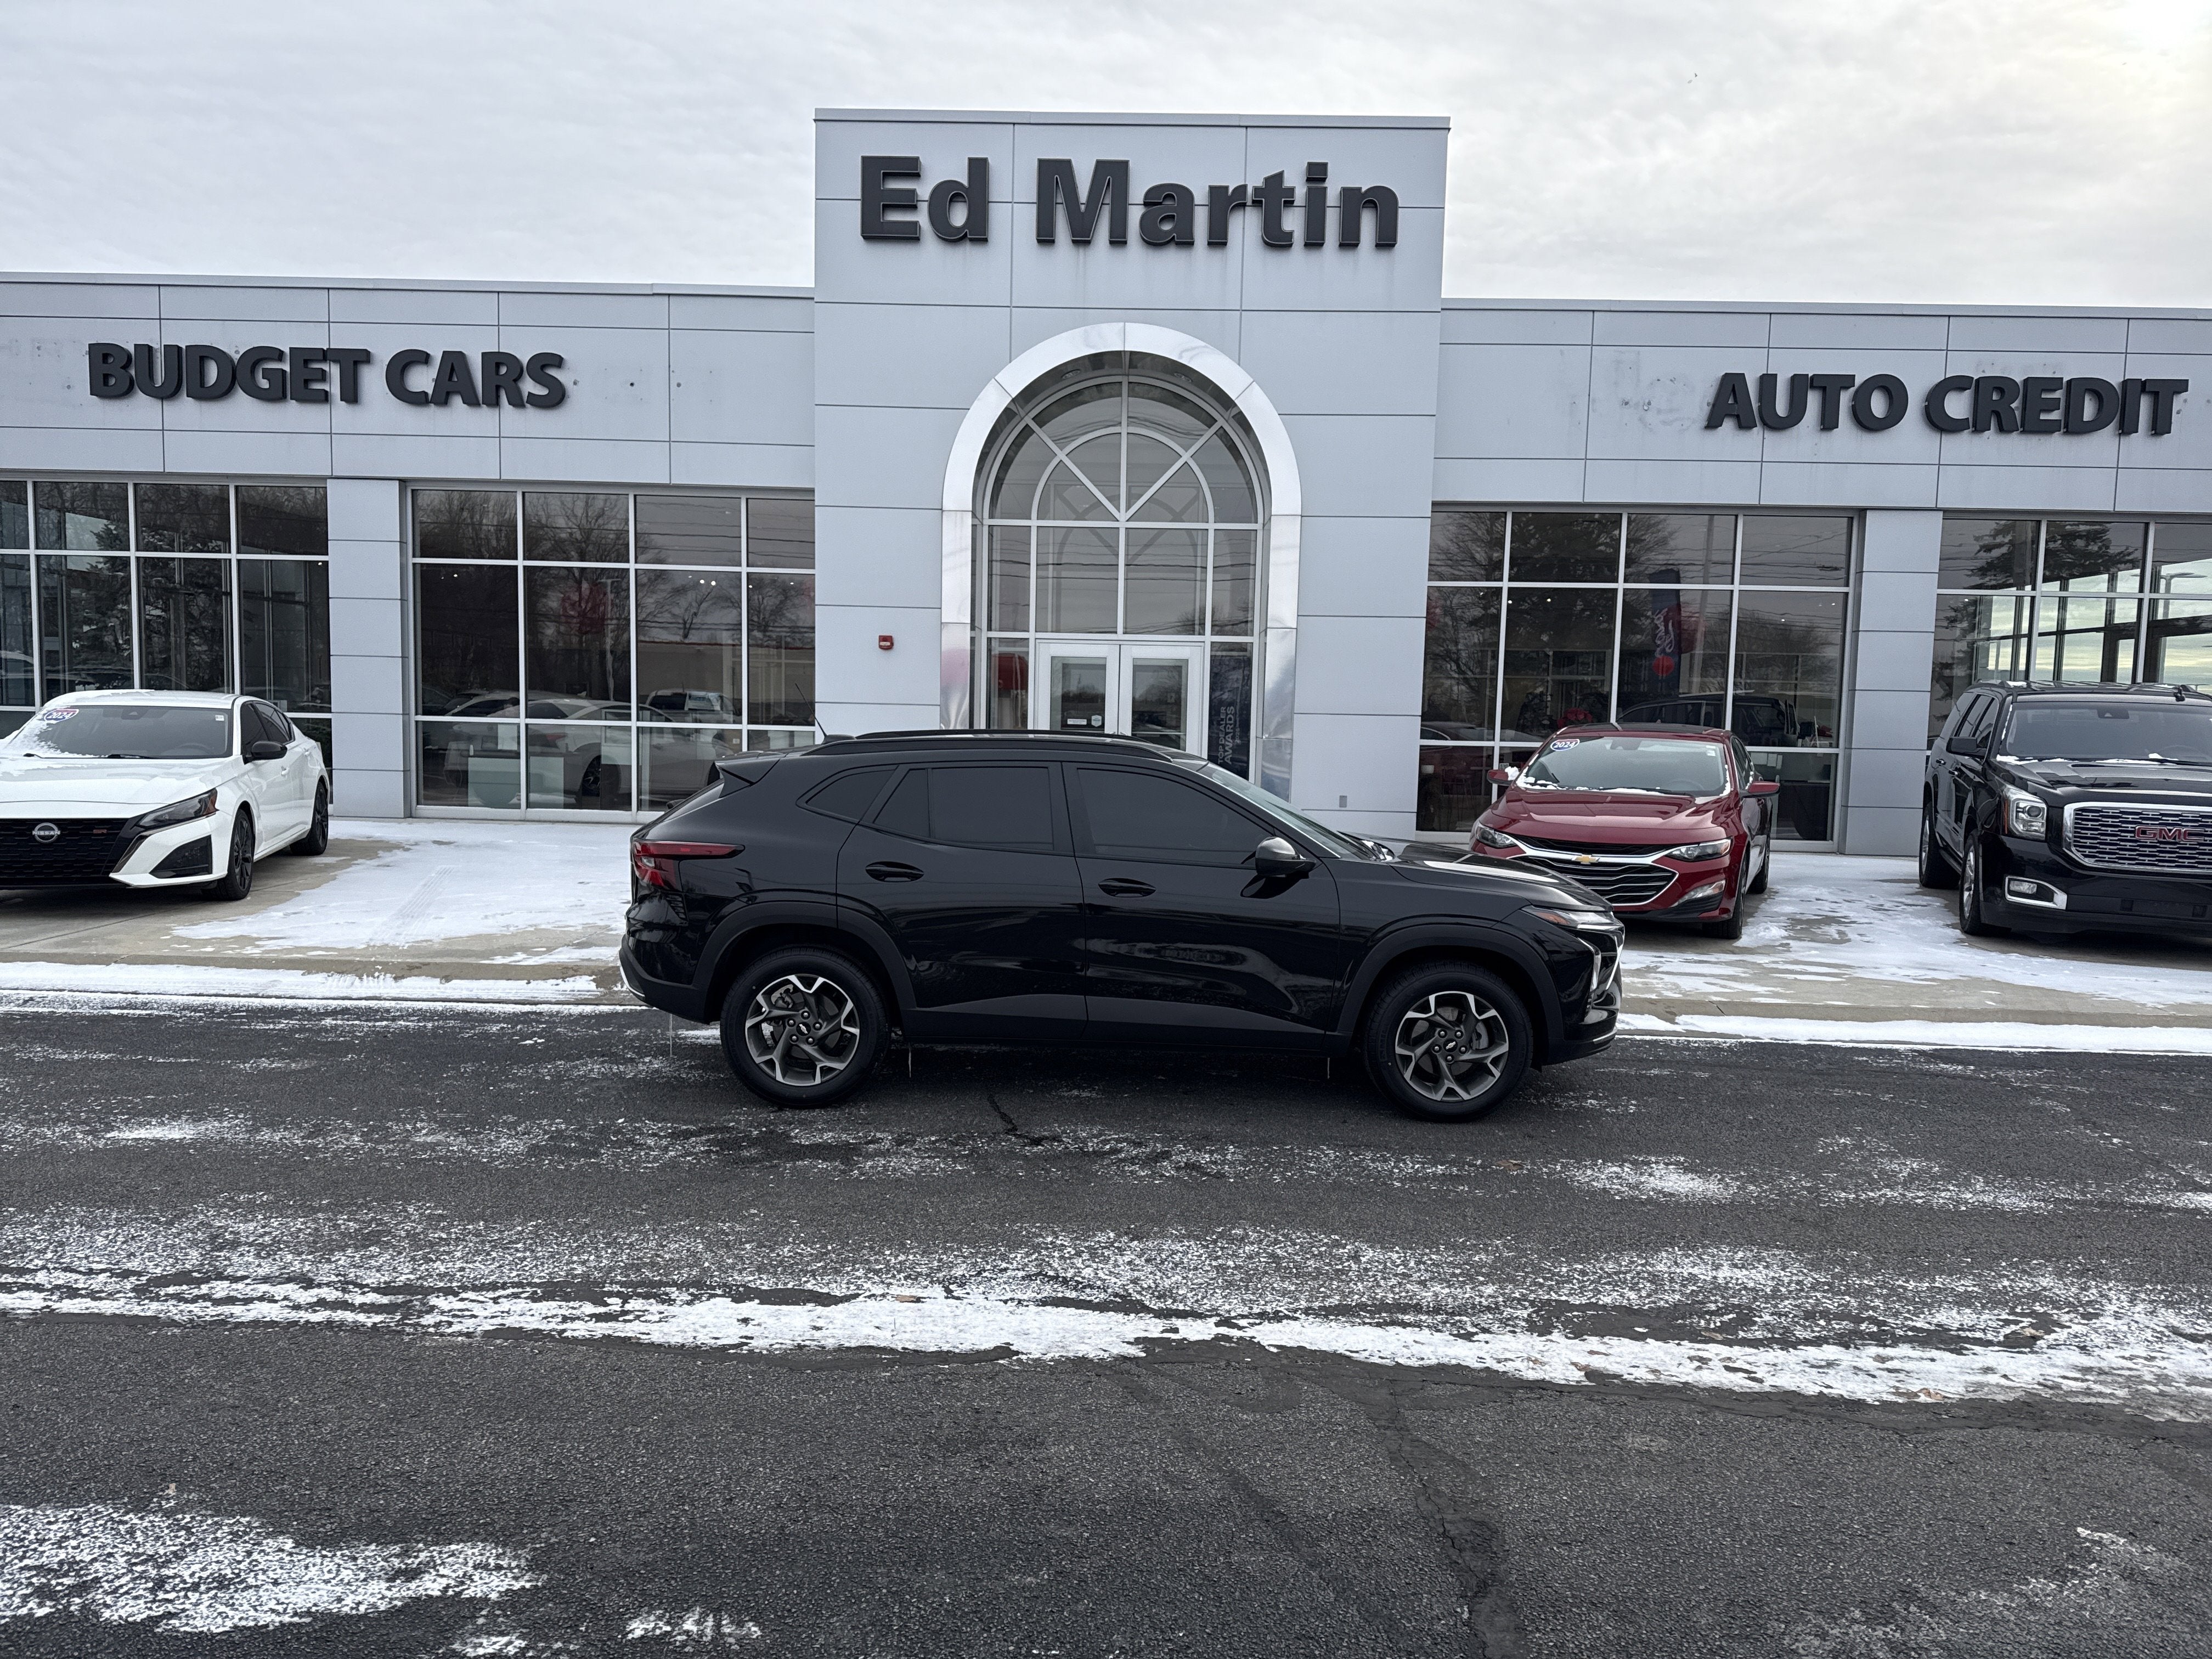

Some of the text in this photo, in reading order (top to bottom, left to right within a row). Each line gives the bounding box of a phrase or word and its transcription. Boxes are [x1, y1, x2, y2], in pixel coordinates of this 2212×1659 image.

[861, 156, 1399, 247] Ed Martin
[88, 342, 565, 408] BUDGET CARS
[1705, 372, 2190, 436] AUTO CREDIT
[1224, 706, 1235, 765] AWARDS
[2135, 825, 2205, 842] GMC
